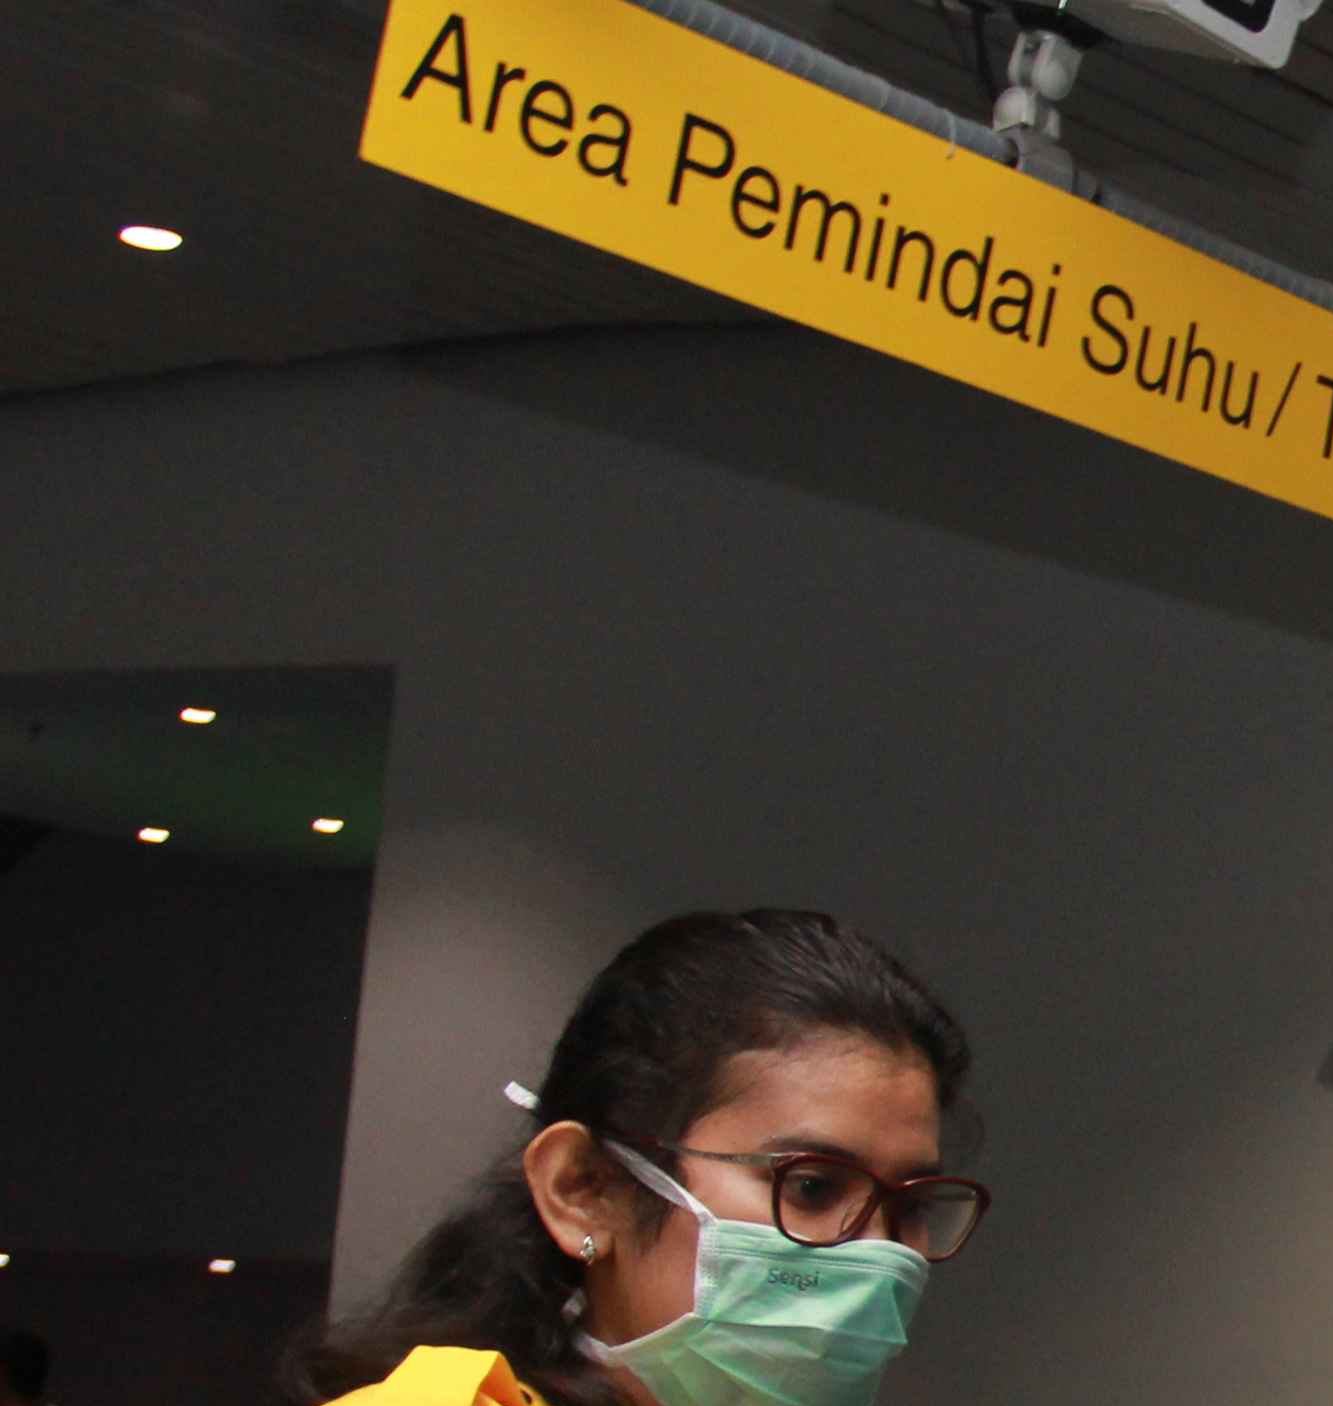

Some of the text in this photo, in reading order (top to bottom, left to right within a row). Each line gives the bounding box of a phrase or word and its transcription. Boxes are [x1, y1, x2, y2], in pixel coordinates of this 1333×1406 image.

[401, 13, 632, 186] Area
[668, 113, 1061, 348] Pemindai
[767, 1267, 820, 1291] Sensi
